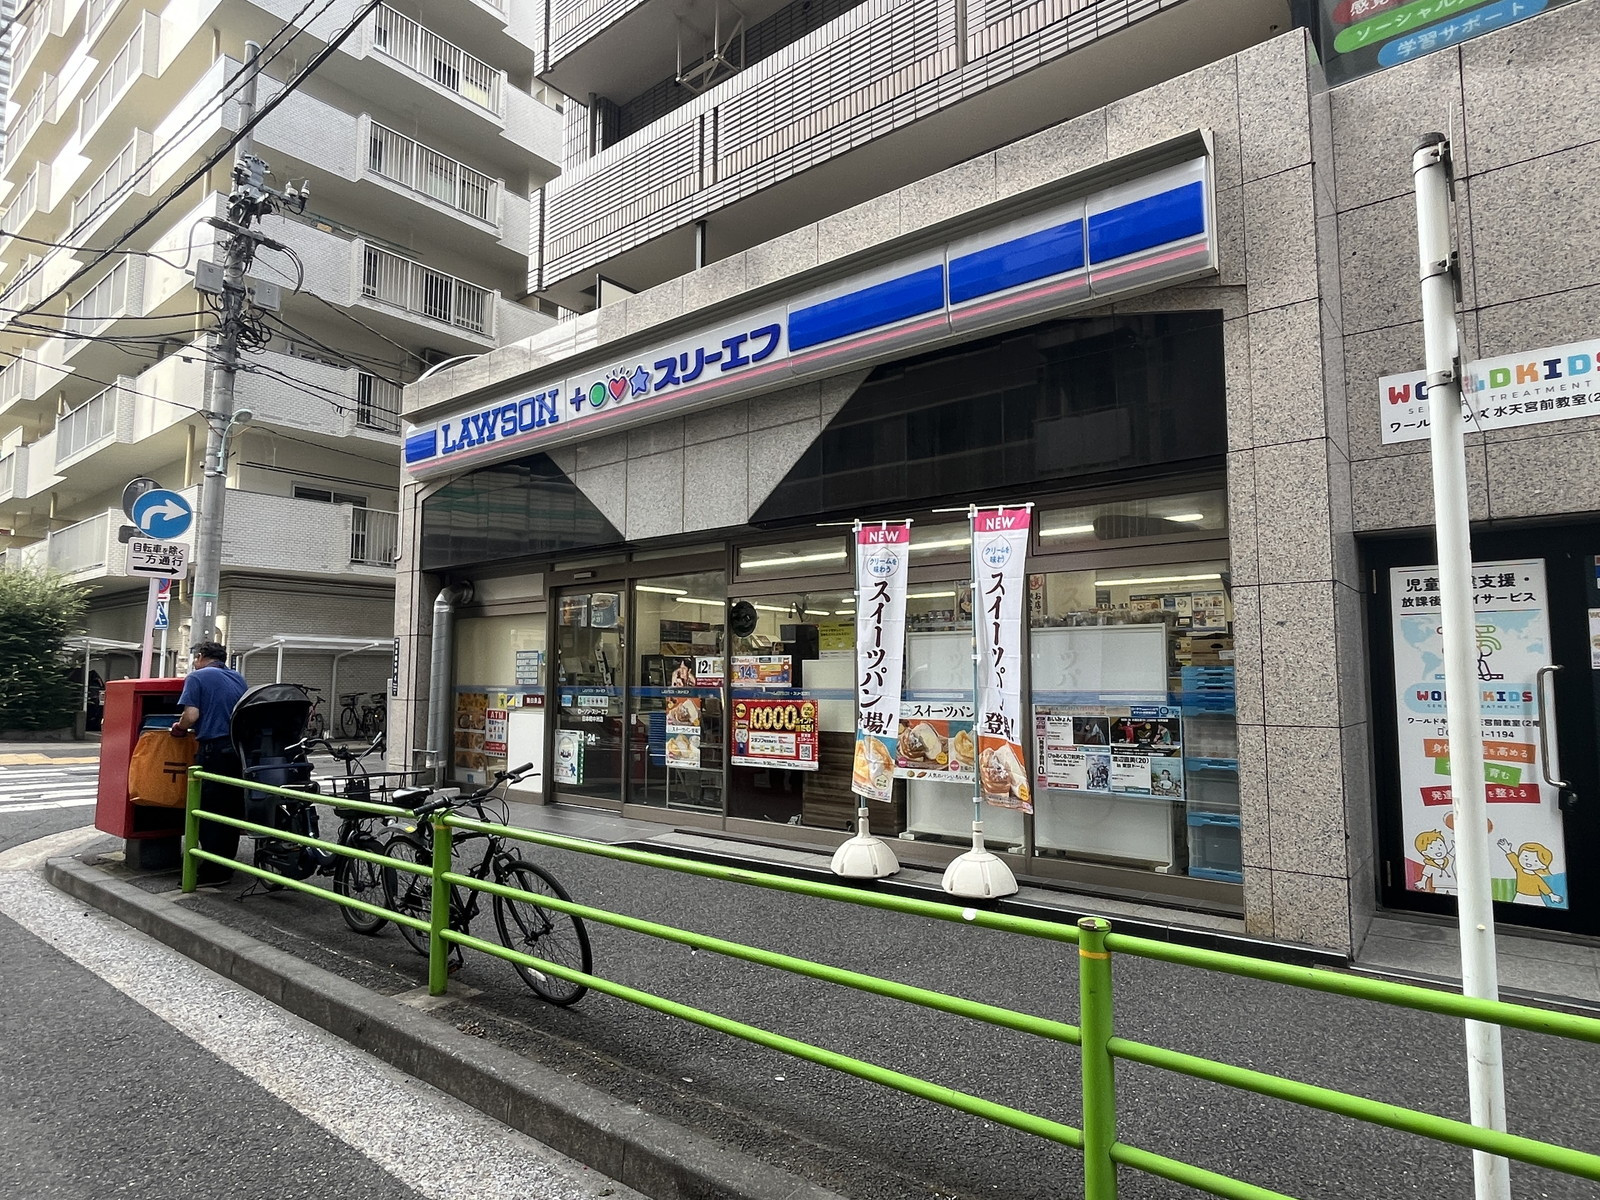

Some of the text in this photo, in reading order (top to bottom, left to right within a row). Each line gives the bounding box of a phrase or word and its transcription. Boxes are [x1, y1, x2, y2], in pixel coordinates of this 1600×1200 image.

[1357, 0, 1465, 41] ソーシャル
[1397, 1, 1526, 57] 学習サポート
[653, 322, 782, 391] スリーエフ
[1489, 379, 1592, 402] TREATMENT
[441, 388, 560, 455] LAWSON
[985, 516, 1016, 531] NEW
[869, 530, 900, 543] NEW
[133, 542, 184, 556] 自転車を除く
[132, 554, 183, 567] 一方通行
[1406, 572, 1530, 593] 児童支援・
[860, 580, 891, 708] スイーツパン
[490, 711, 504, 719] ATM
[912, 704, 974, 718] スイーツパン
[859, 712, 894, 736] 場!
